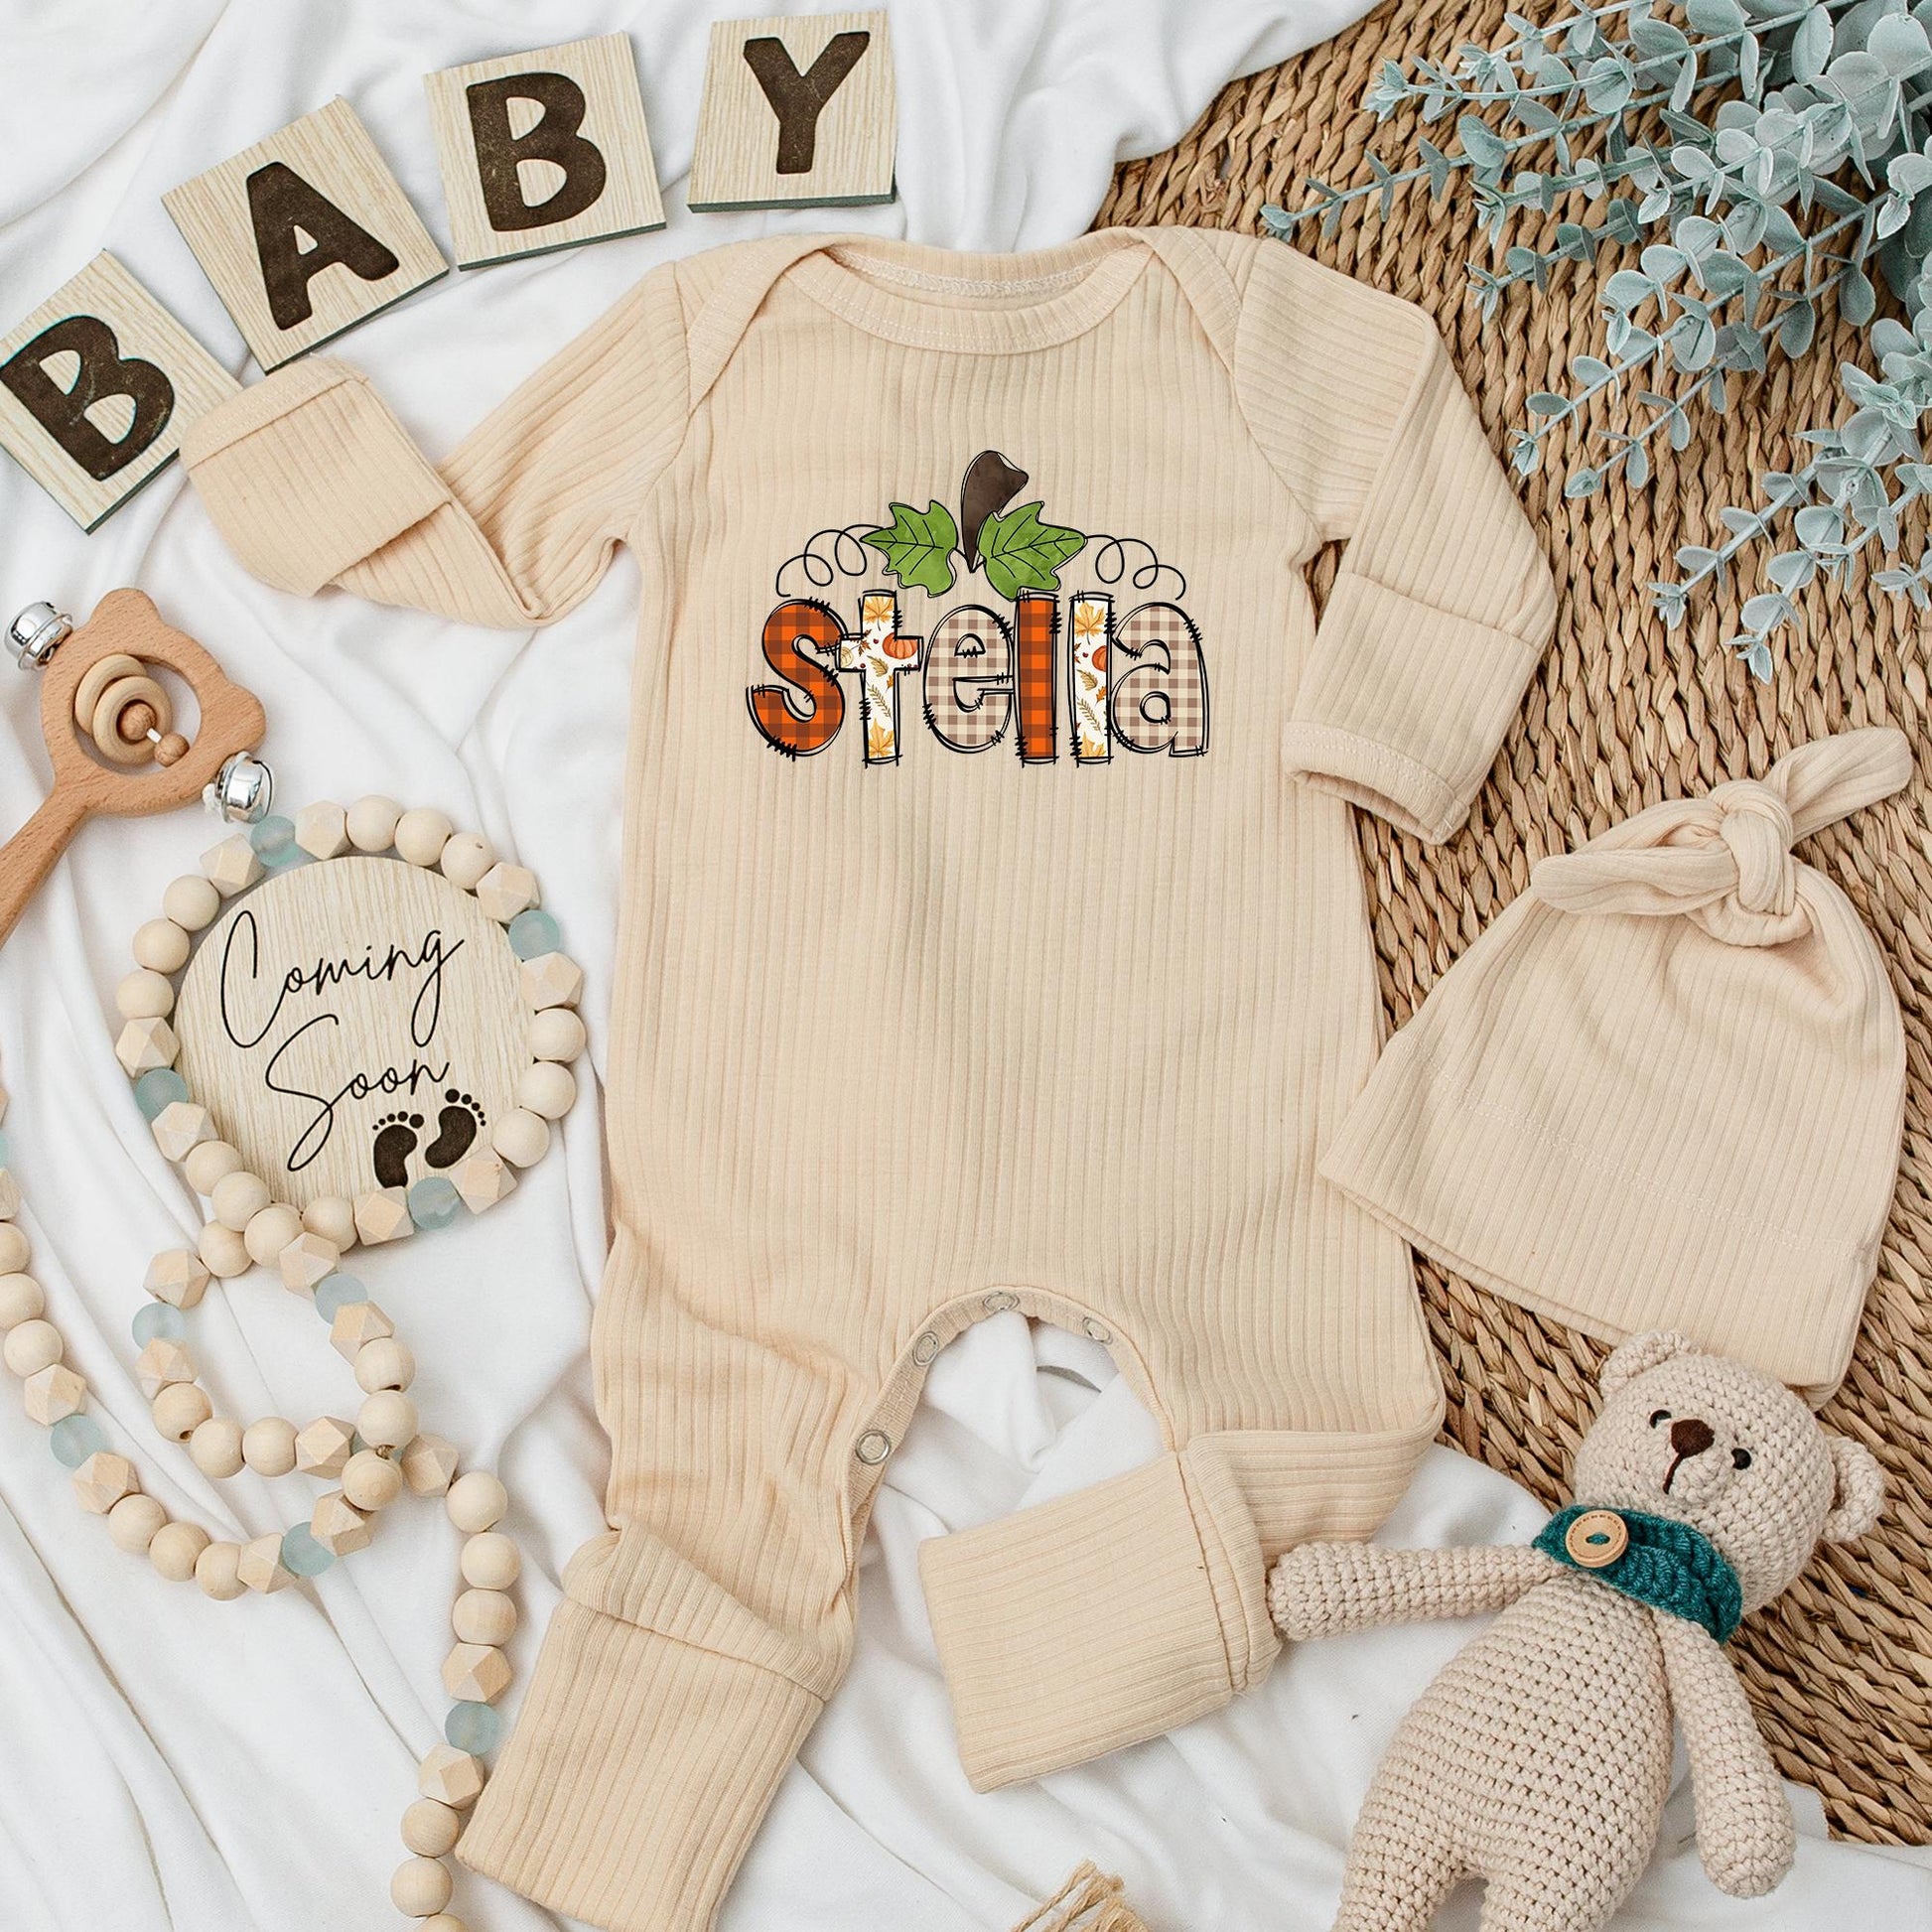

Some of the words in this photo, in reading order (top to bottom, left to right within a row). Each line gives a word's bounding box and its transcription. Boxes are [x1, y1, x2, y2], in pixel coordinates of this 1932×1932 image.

[0, 32, 871, 483] BABY
[220, 910, 465, 1048] Coming
[265, 1014, 450, 1172] Soon
